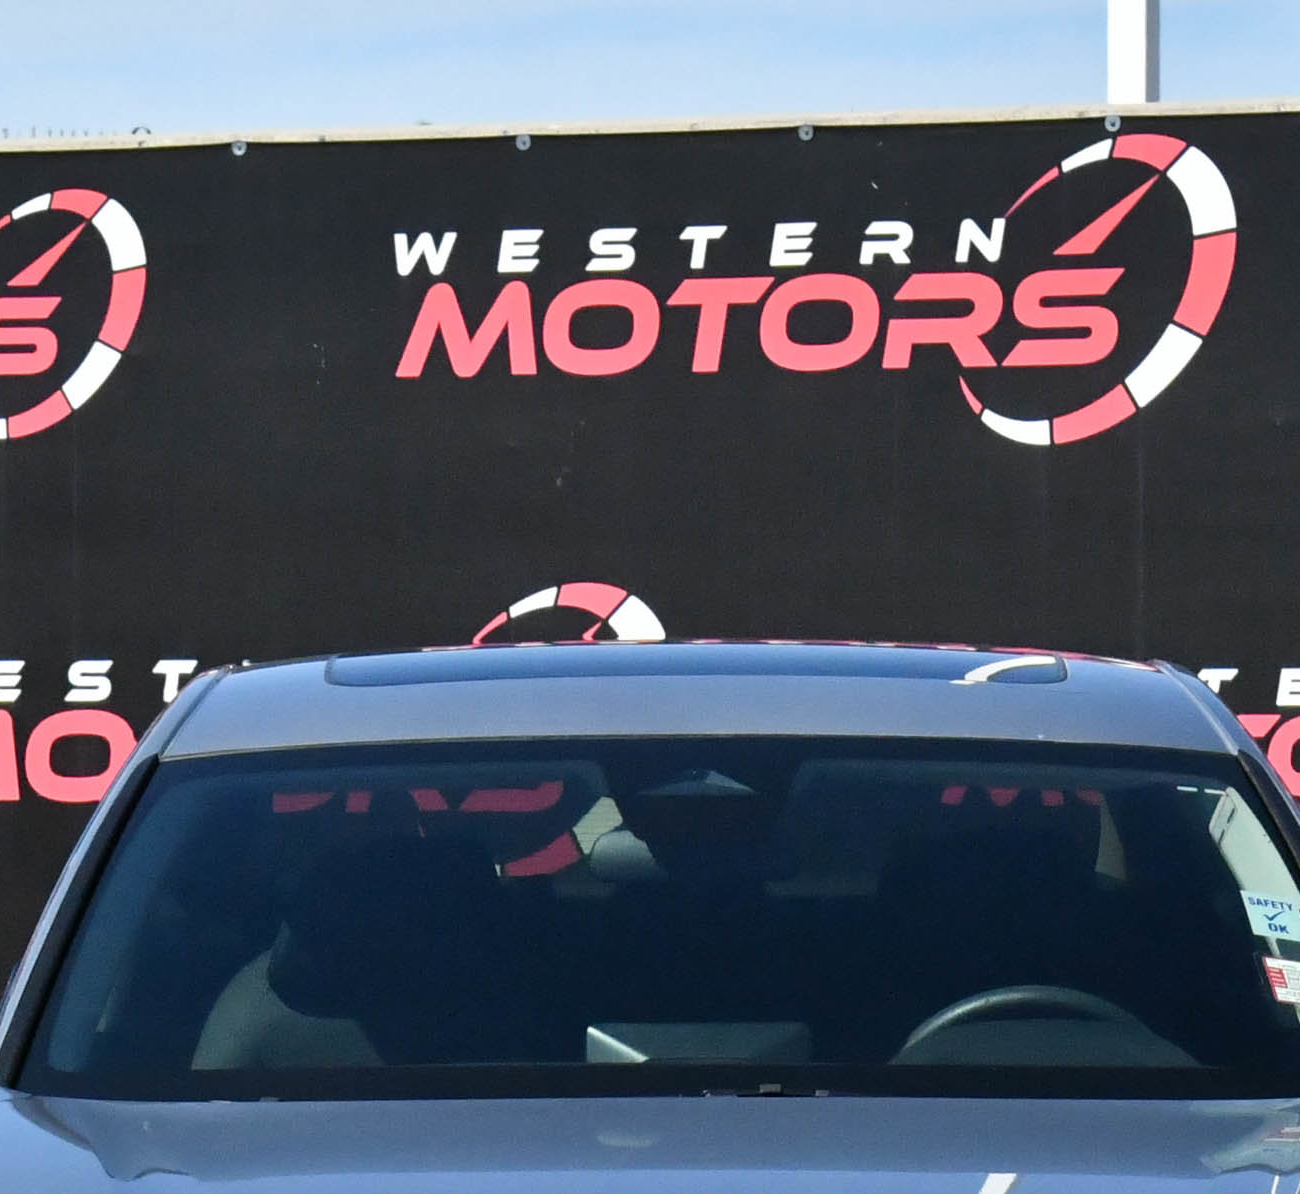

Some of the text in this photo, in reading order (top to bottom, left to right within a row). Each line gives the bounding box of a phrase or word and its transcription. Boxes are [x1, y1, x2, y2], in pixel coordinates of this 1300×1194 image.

[394, 218, 1005, 276] WESTERN
[395, 268, 1125, 378] MOTORS
[1248, 896, 1293, 912] SAFETY
[1268, 922, 1289, 934] OK
